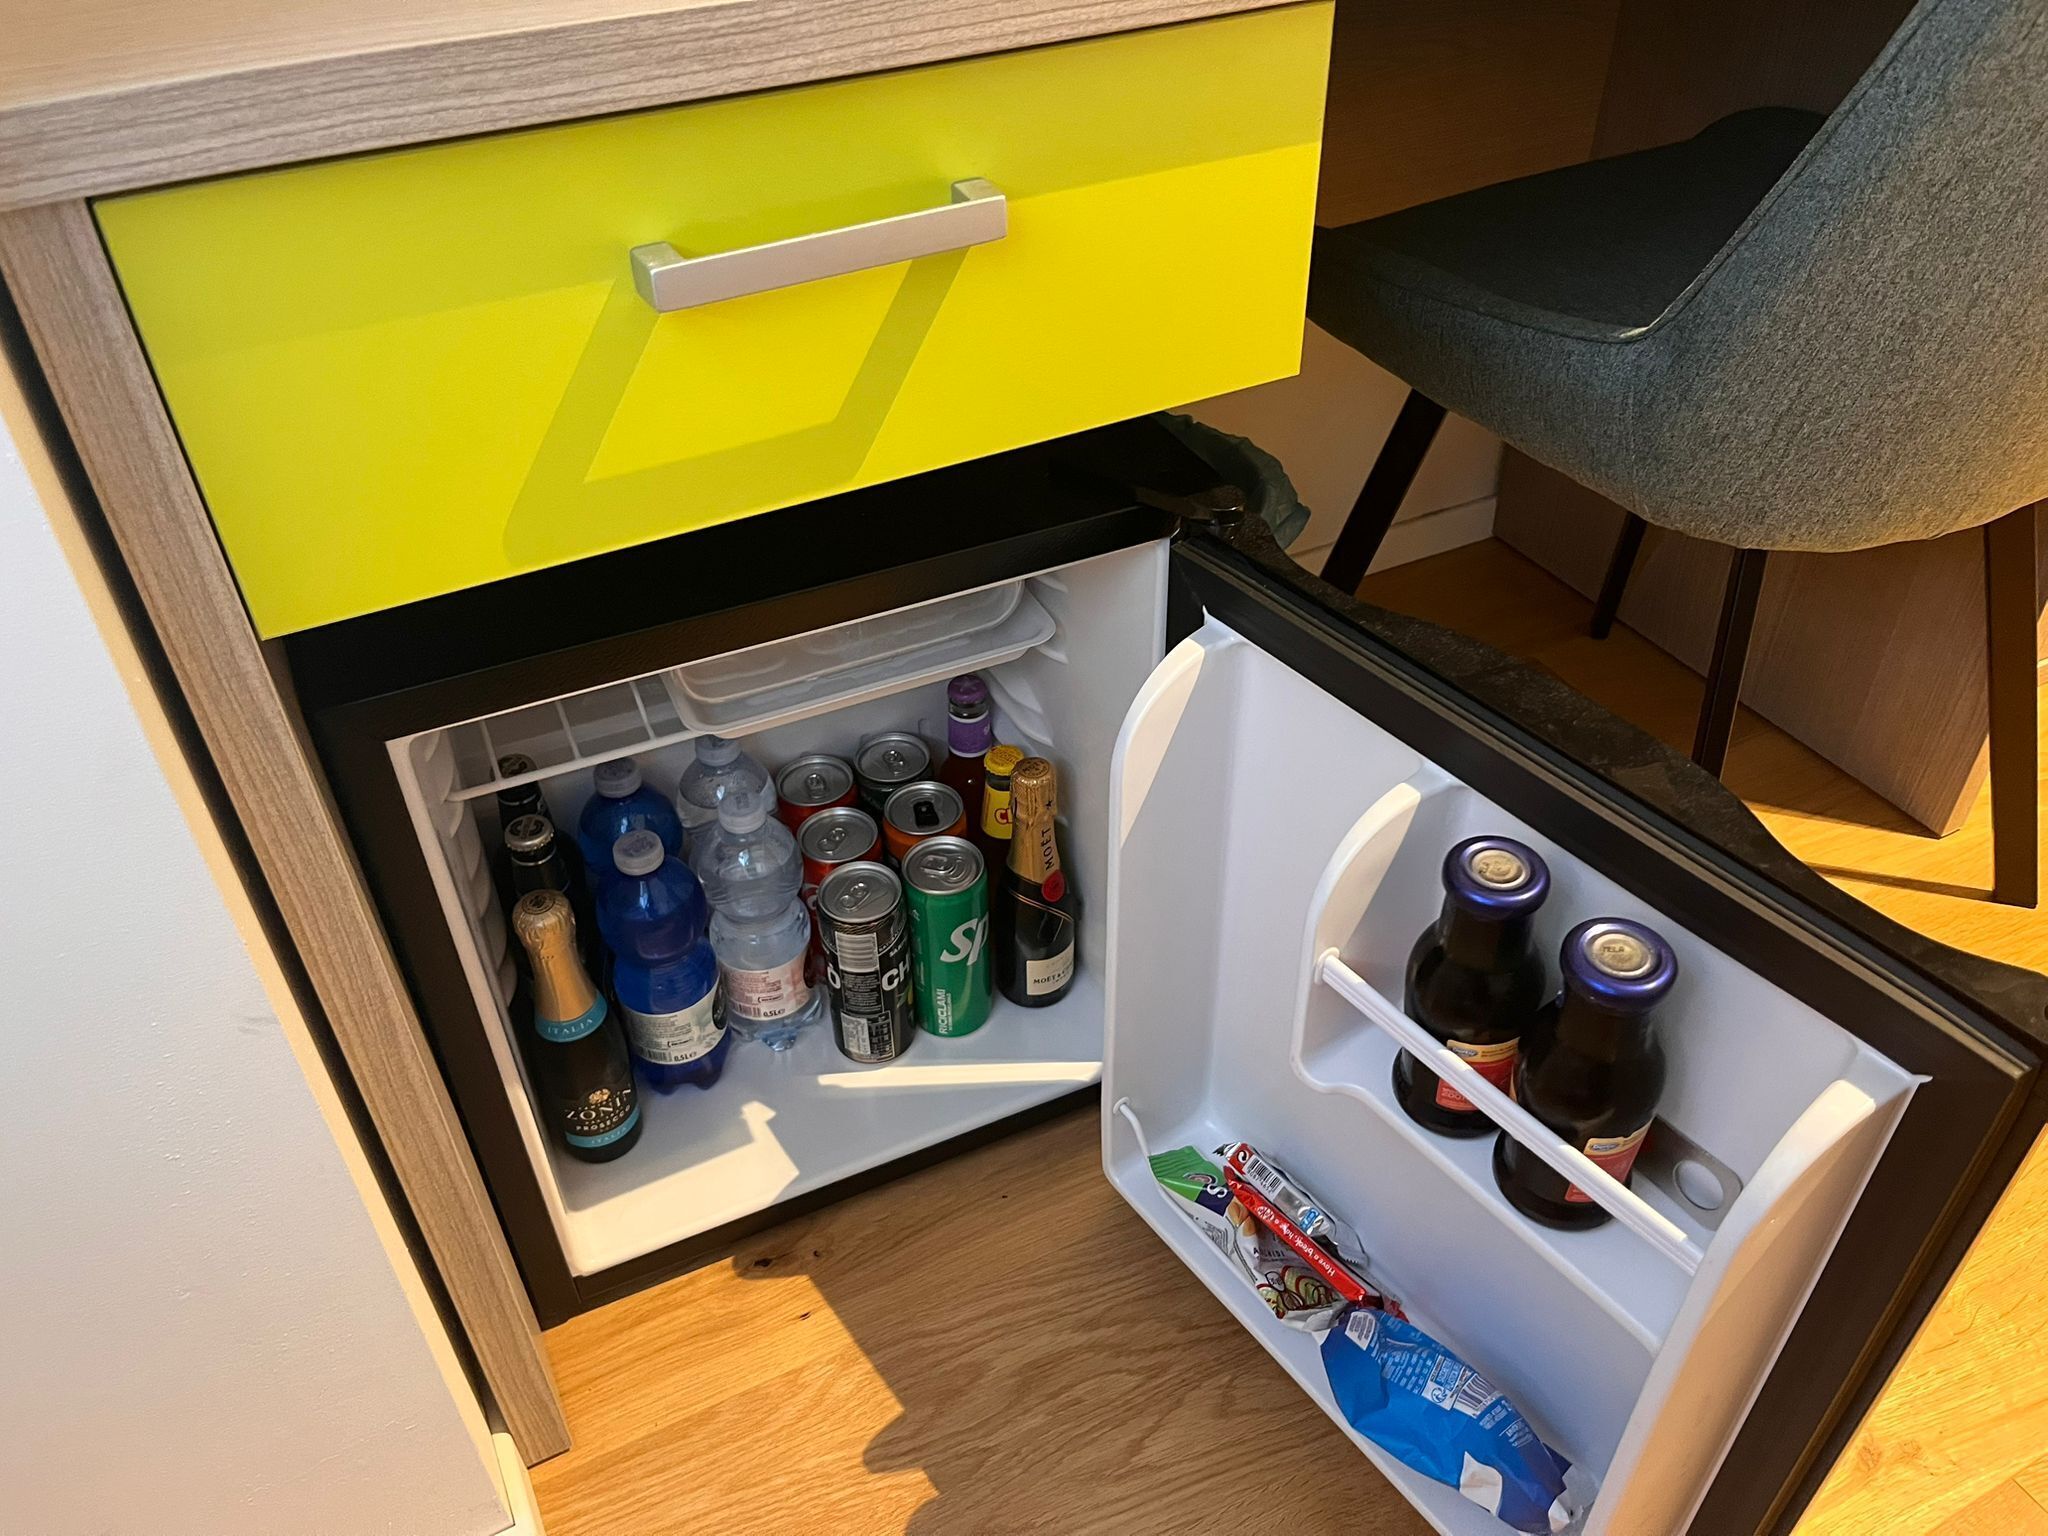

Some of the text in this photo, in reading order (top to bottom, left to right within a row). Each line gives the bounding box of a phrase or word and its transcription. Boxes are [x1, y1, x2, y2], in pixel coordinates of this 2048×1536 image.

[936, 989, 948, 1034] RICICLAMI
[547, 1018, 593, 1035] ITALIA
[575, 1104, 631, 1131] PROSECCO
[1318, 1256, 1336, 1276] Have
